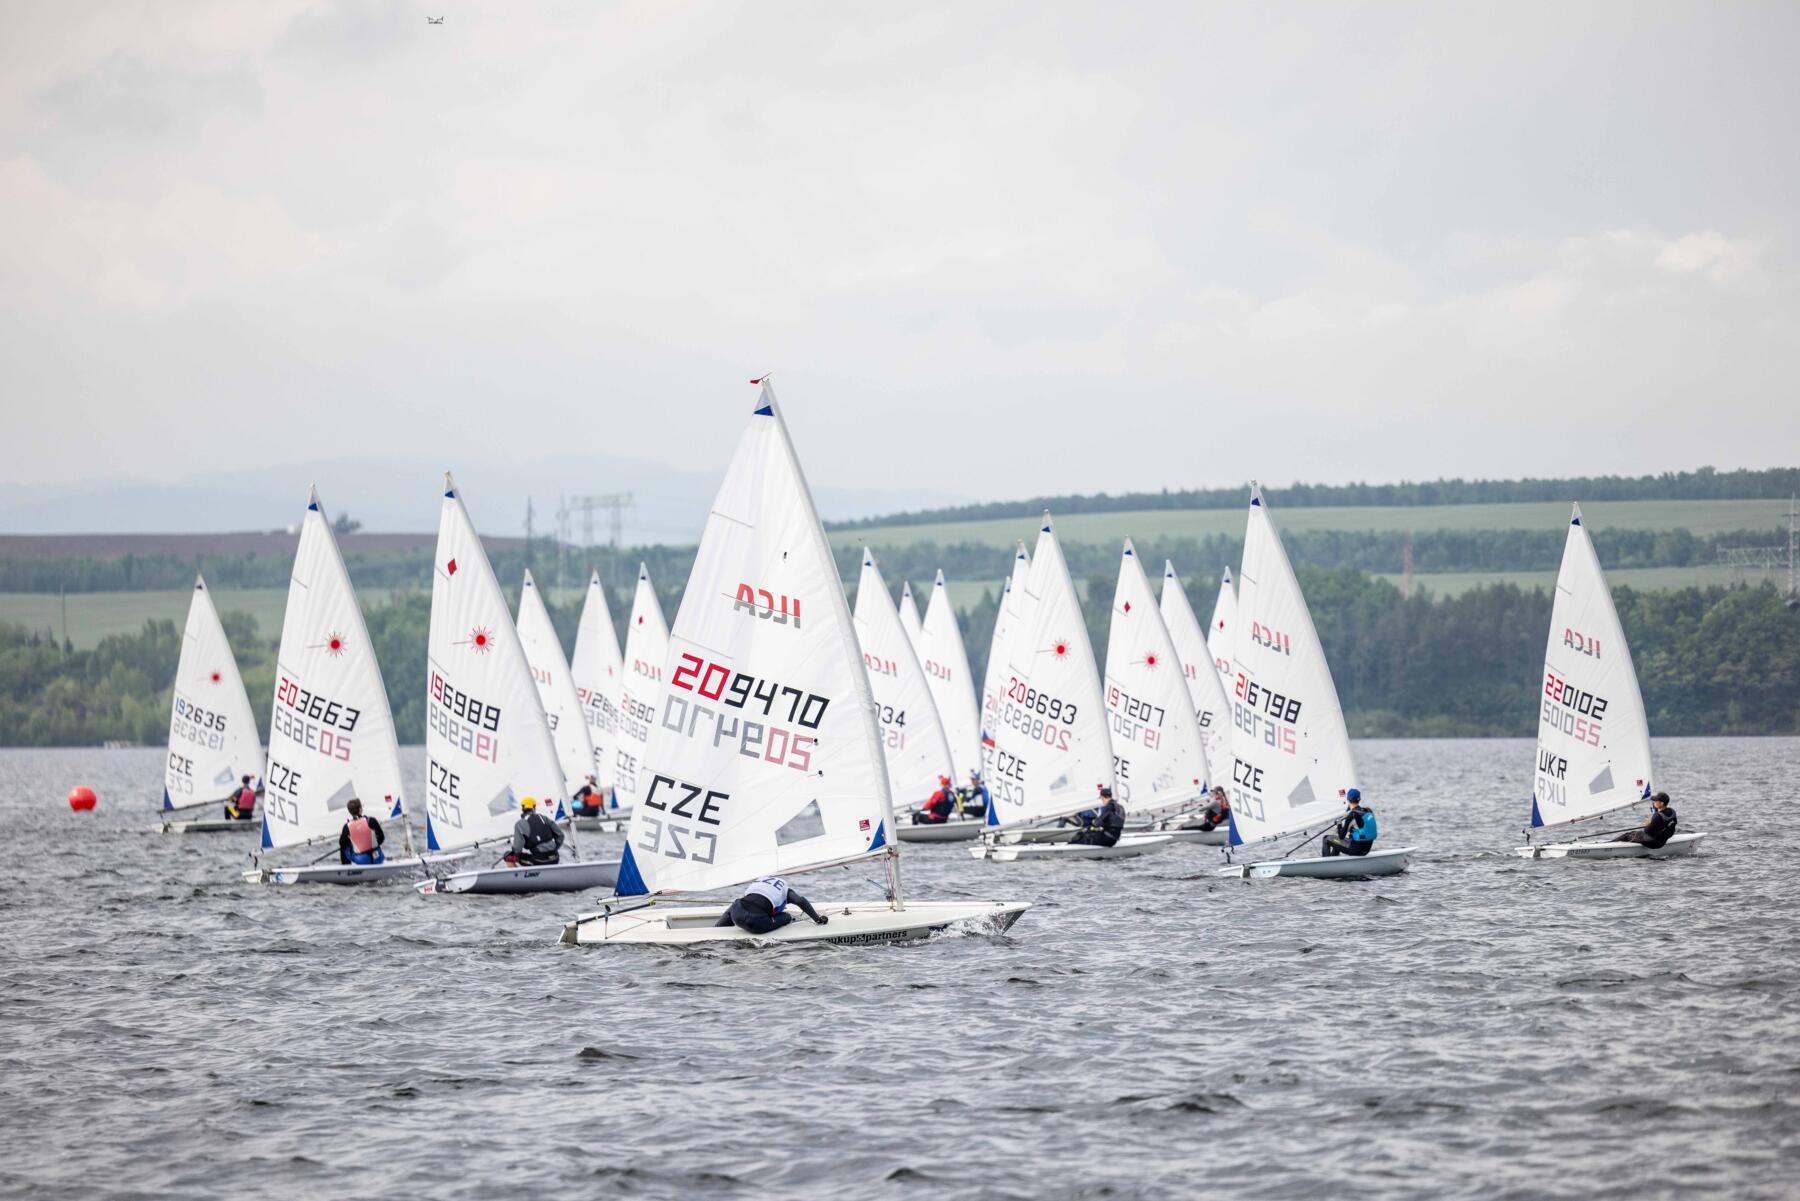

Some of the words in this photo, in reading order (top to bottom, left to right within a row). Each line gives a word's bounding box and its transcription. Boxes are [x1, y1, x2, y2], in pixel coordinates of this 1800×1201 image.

[278, 676, 360, 732] 203663
[430, 670, 501, 732] 196989
[672, 653, 831, 730] 209470
[1008, 676, 1077, 725] 208693
[1107, 685, 1165, 728] 197207
[1235, 672, 1302, 724] 216798
[1545, 673, 1608, 721] 220102
[175, 697, 228, 732] 192635
[169, 752, 194, 777] CZE
[269, 762, 302, 796] CZE
[430, 759, 460, 800] CZE
[617, 750, 638, 774] CZE
[997, 751, 1027, 781] CZE
[1113, 756, 1130, 779] ZE
[1233, 758, 1264, 792] CZE
[1539, 749, 1568, 781] UKR
[645, 774, 730, 826] CZE
[754, 877, 785, 891] ZE
[866, 930, 908, 943] partners
